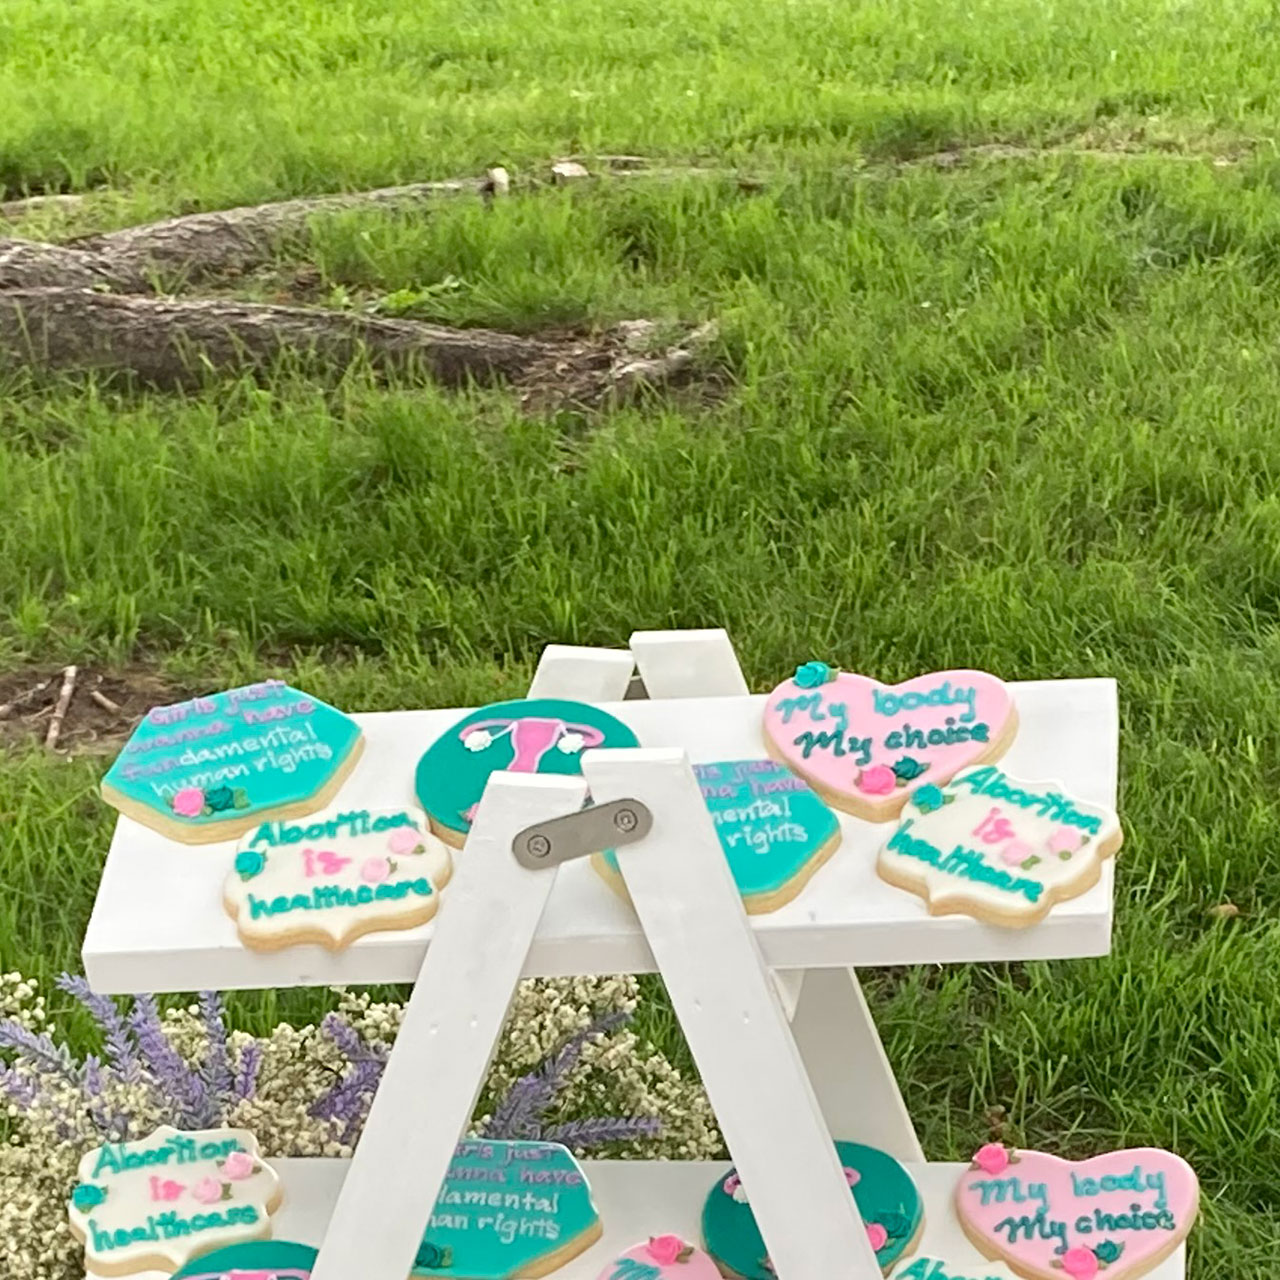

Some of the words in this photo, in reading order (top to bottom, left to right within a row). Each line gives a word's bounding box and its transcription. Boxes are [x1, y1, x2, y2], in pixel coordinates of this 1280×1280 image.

[775, 692, 849, 732] My
[872, 682, 976, 722] body
[253, 741, 333, 773] rights
[794, 730, 872, 766] My
[884, 717, 990, 750] choice
[951, 766, 1101, 834] Abortion
[249, 810, 418, 848] Abortion
[726, 822, 808, 855] rights
[972, 807, 1015, 844] is
[302, 848, 352, 878] is
[887, 818, 1044, 903] healthcare
[248, 877, 433, 920] healthcare
[92, 1135, 247, 1179] Abortion
[969, 1175, 1051, 1214] My
[1071, 1165, 1168, 1210] body
[89, 1205, 260, 1252] healthcare
[478, 1212, 561, 1244] rights
[994, 1211, 1069, 1255] My
[1075, 1203, 1177, 1233] choice
